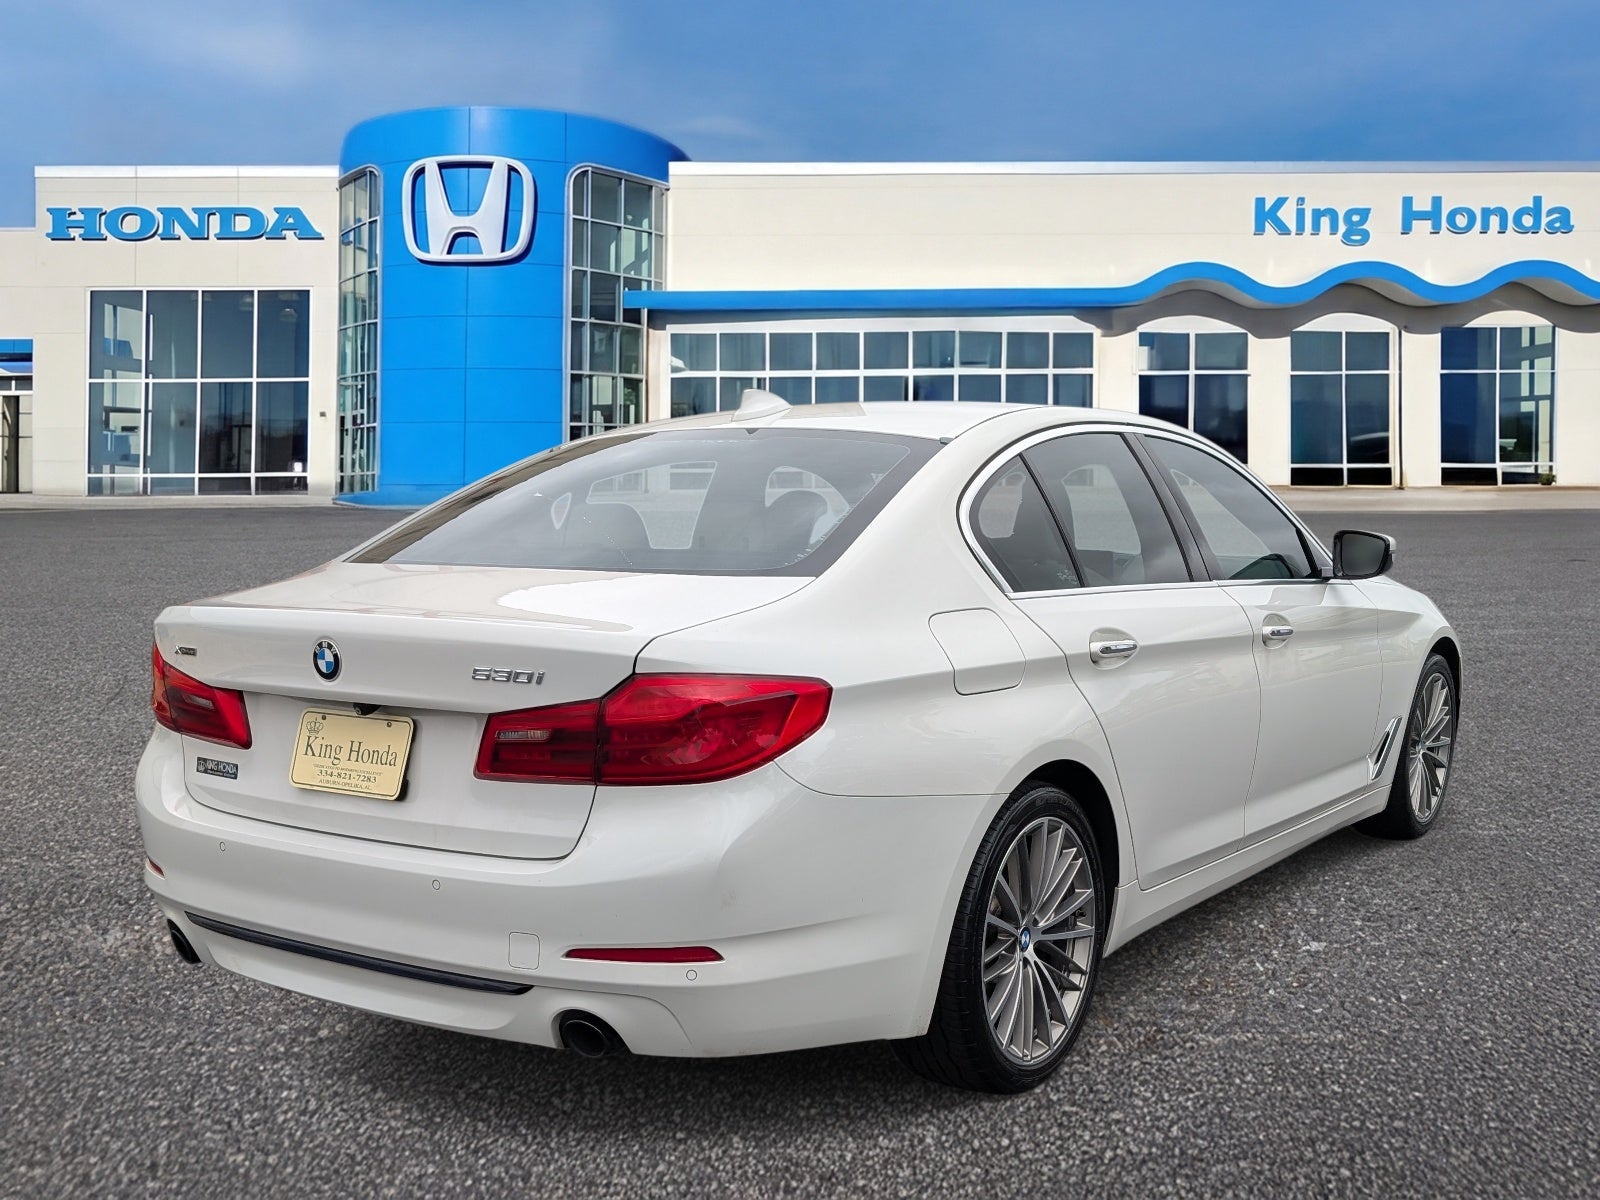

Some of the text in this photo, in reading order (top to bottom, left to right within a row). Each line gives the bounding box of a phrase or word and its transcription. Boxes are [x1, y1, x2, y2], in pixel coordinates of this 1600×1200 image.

[46, 206, 325, 241] HONDA
[1253, 195, 1575, 246] King Honda
[472, 667, 545, 685] 530i
[303, 735, 397, 767] King Honda
[317, 769, 377, 783] 334-821-7283
